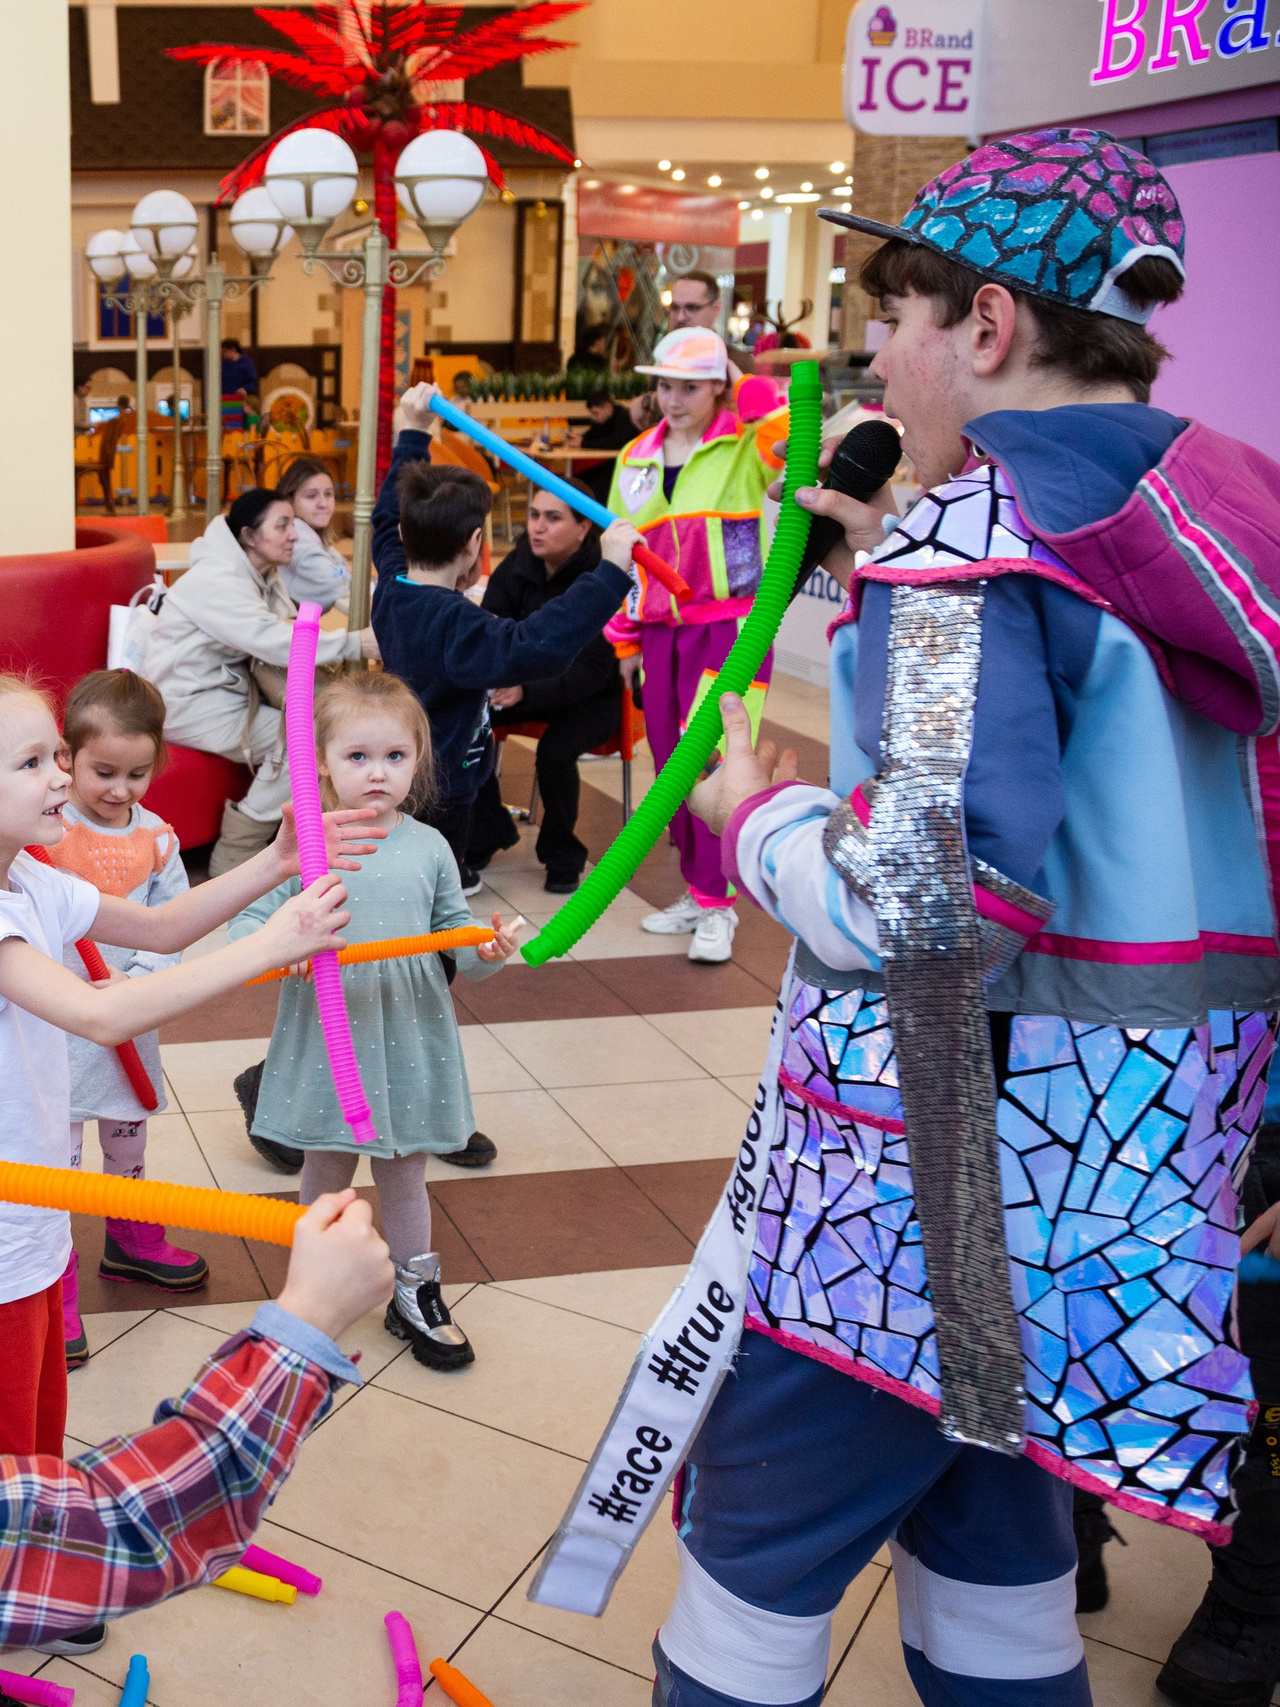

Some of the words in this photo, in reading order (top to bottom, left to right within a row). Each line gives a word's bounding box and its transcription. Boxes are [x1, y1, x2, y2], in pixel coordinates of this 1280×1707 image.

[904, 27, 974, 49] BRand
[1089, 0, 1280, 87] BRa
[858, 56, 972, 113] ICE
[588, 1425, 673, 1524] #race
[647, 1280, 735, 1396] #true
